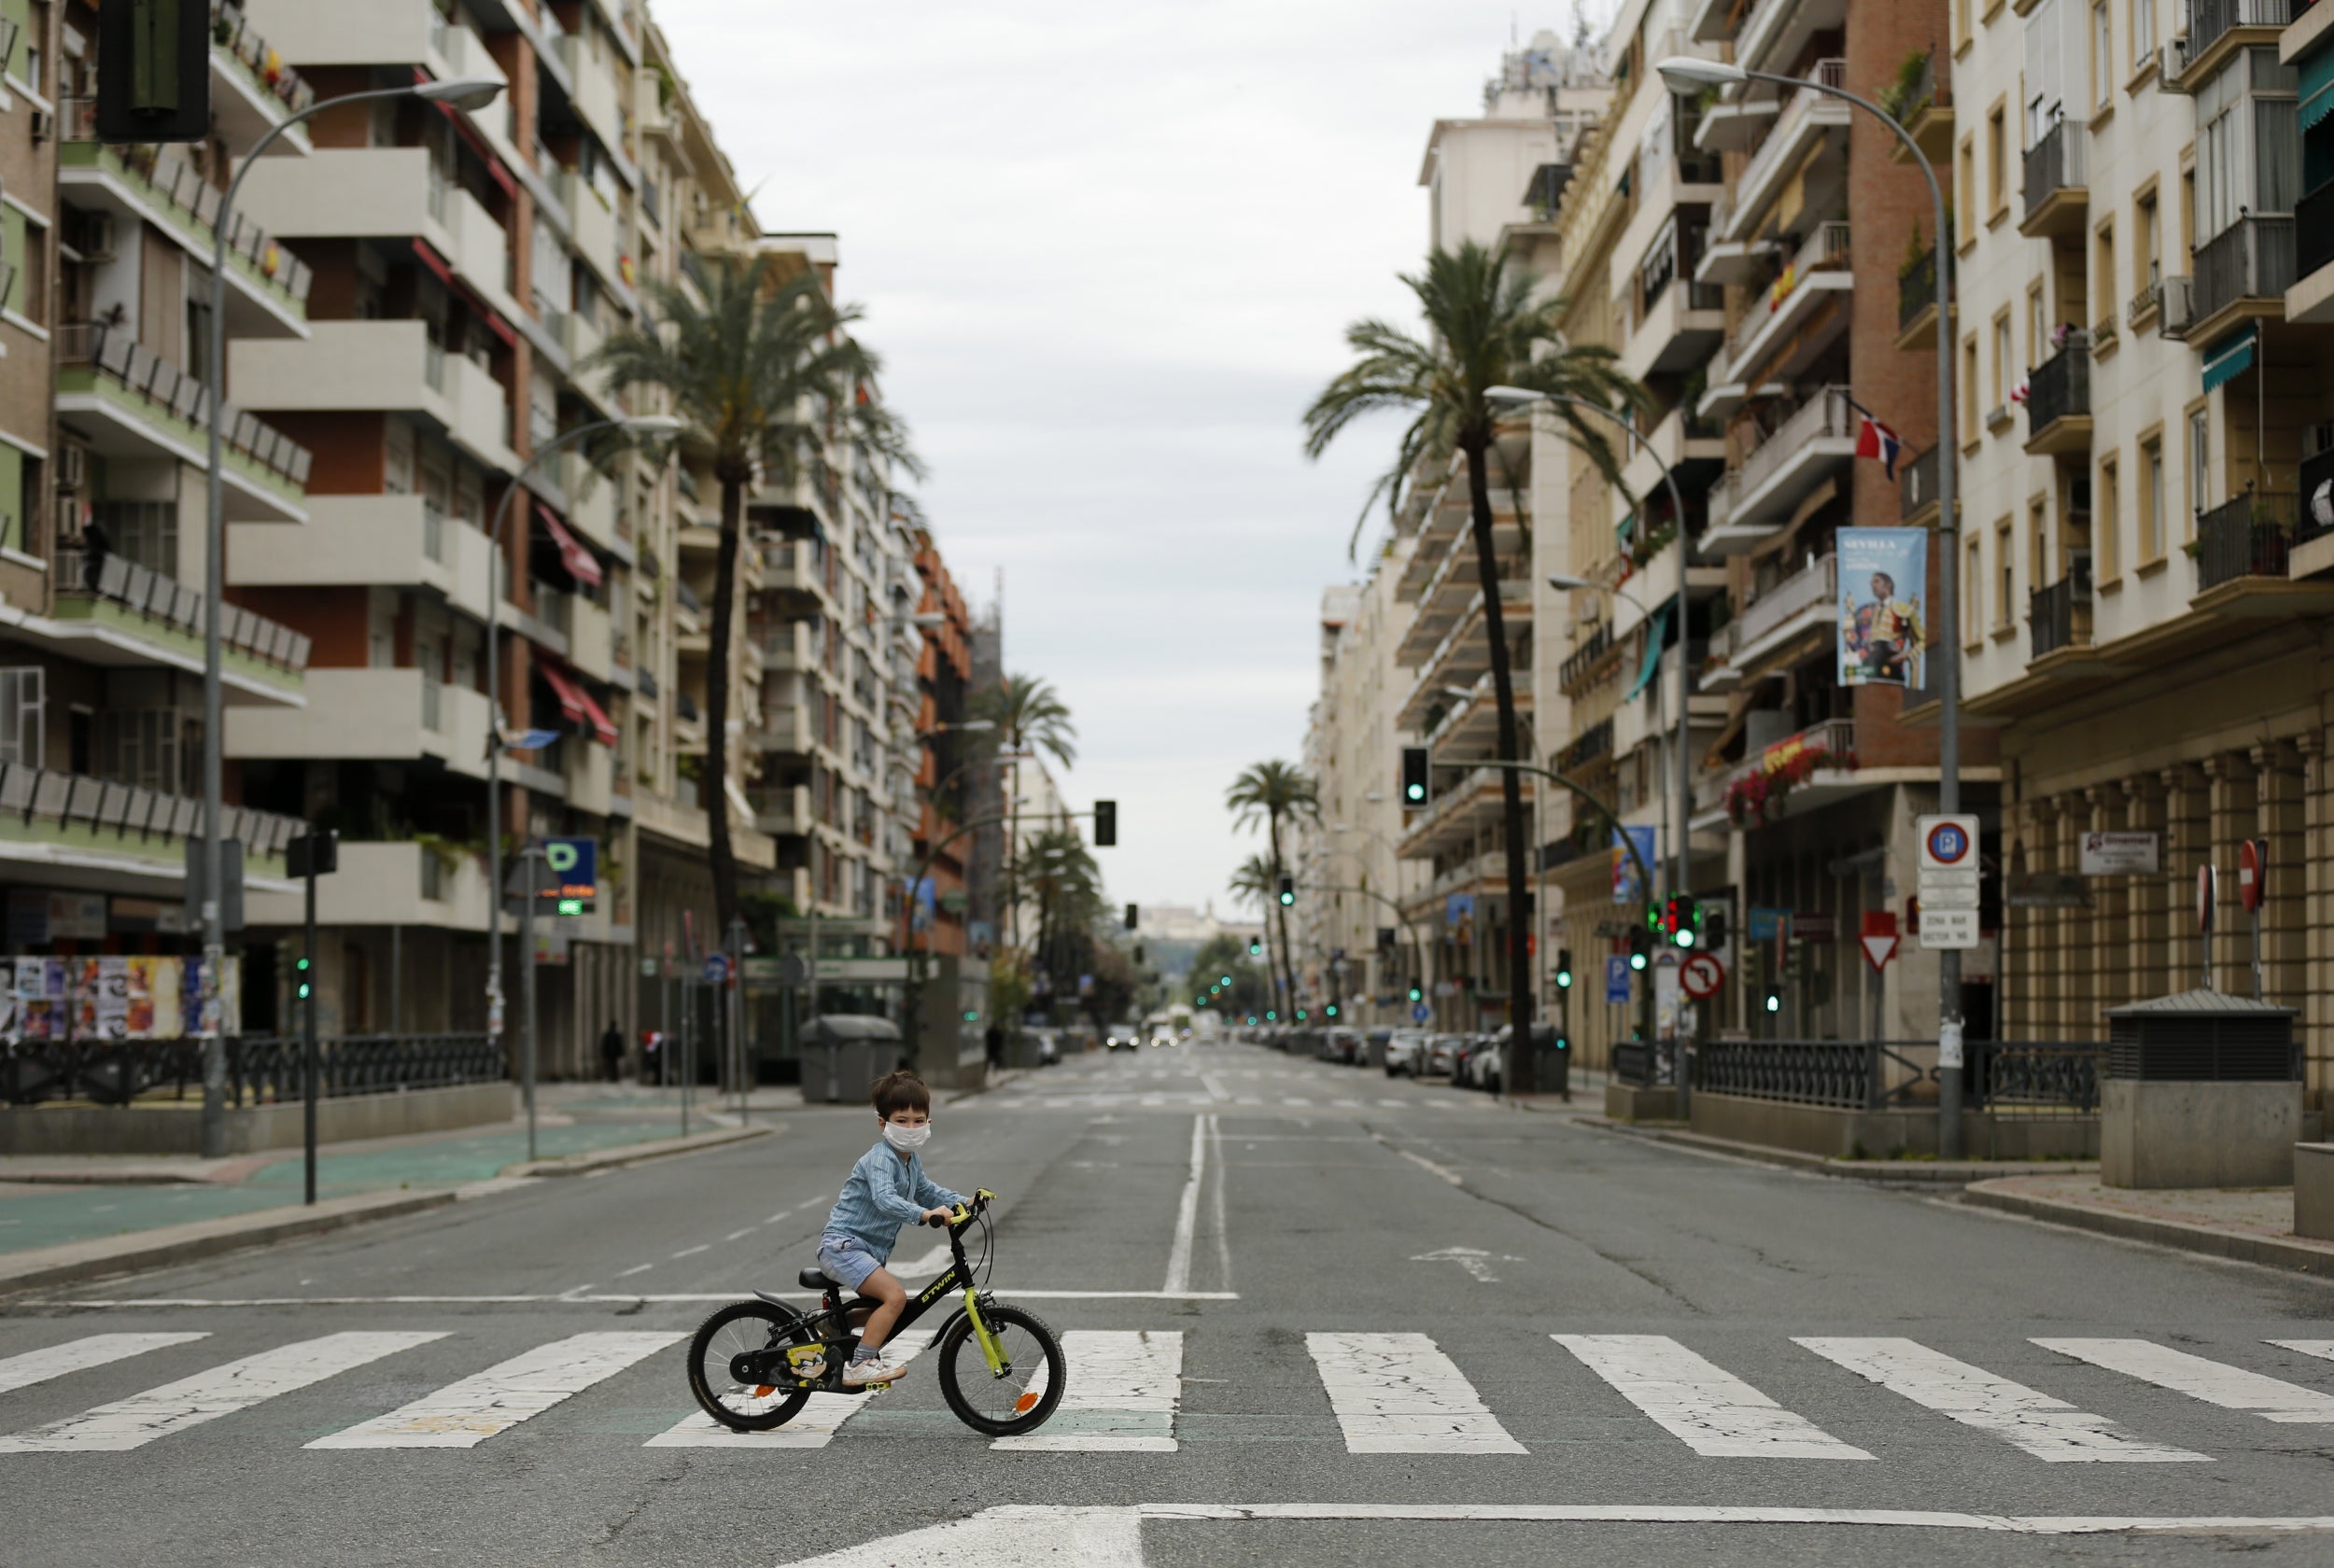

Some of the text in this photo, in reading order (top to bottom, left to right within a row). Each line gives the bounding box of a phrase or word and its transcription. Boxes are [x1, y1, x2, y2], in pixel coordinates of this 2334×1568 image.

[1844, 539, 1896, 550] SEVILLA
[1926, 916, 1945, 926] ZONA
[1923, 931, 1949, 942] SECTOR
[921, 1270, 955, 1303] BTWIN
